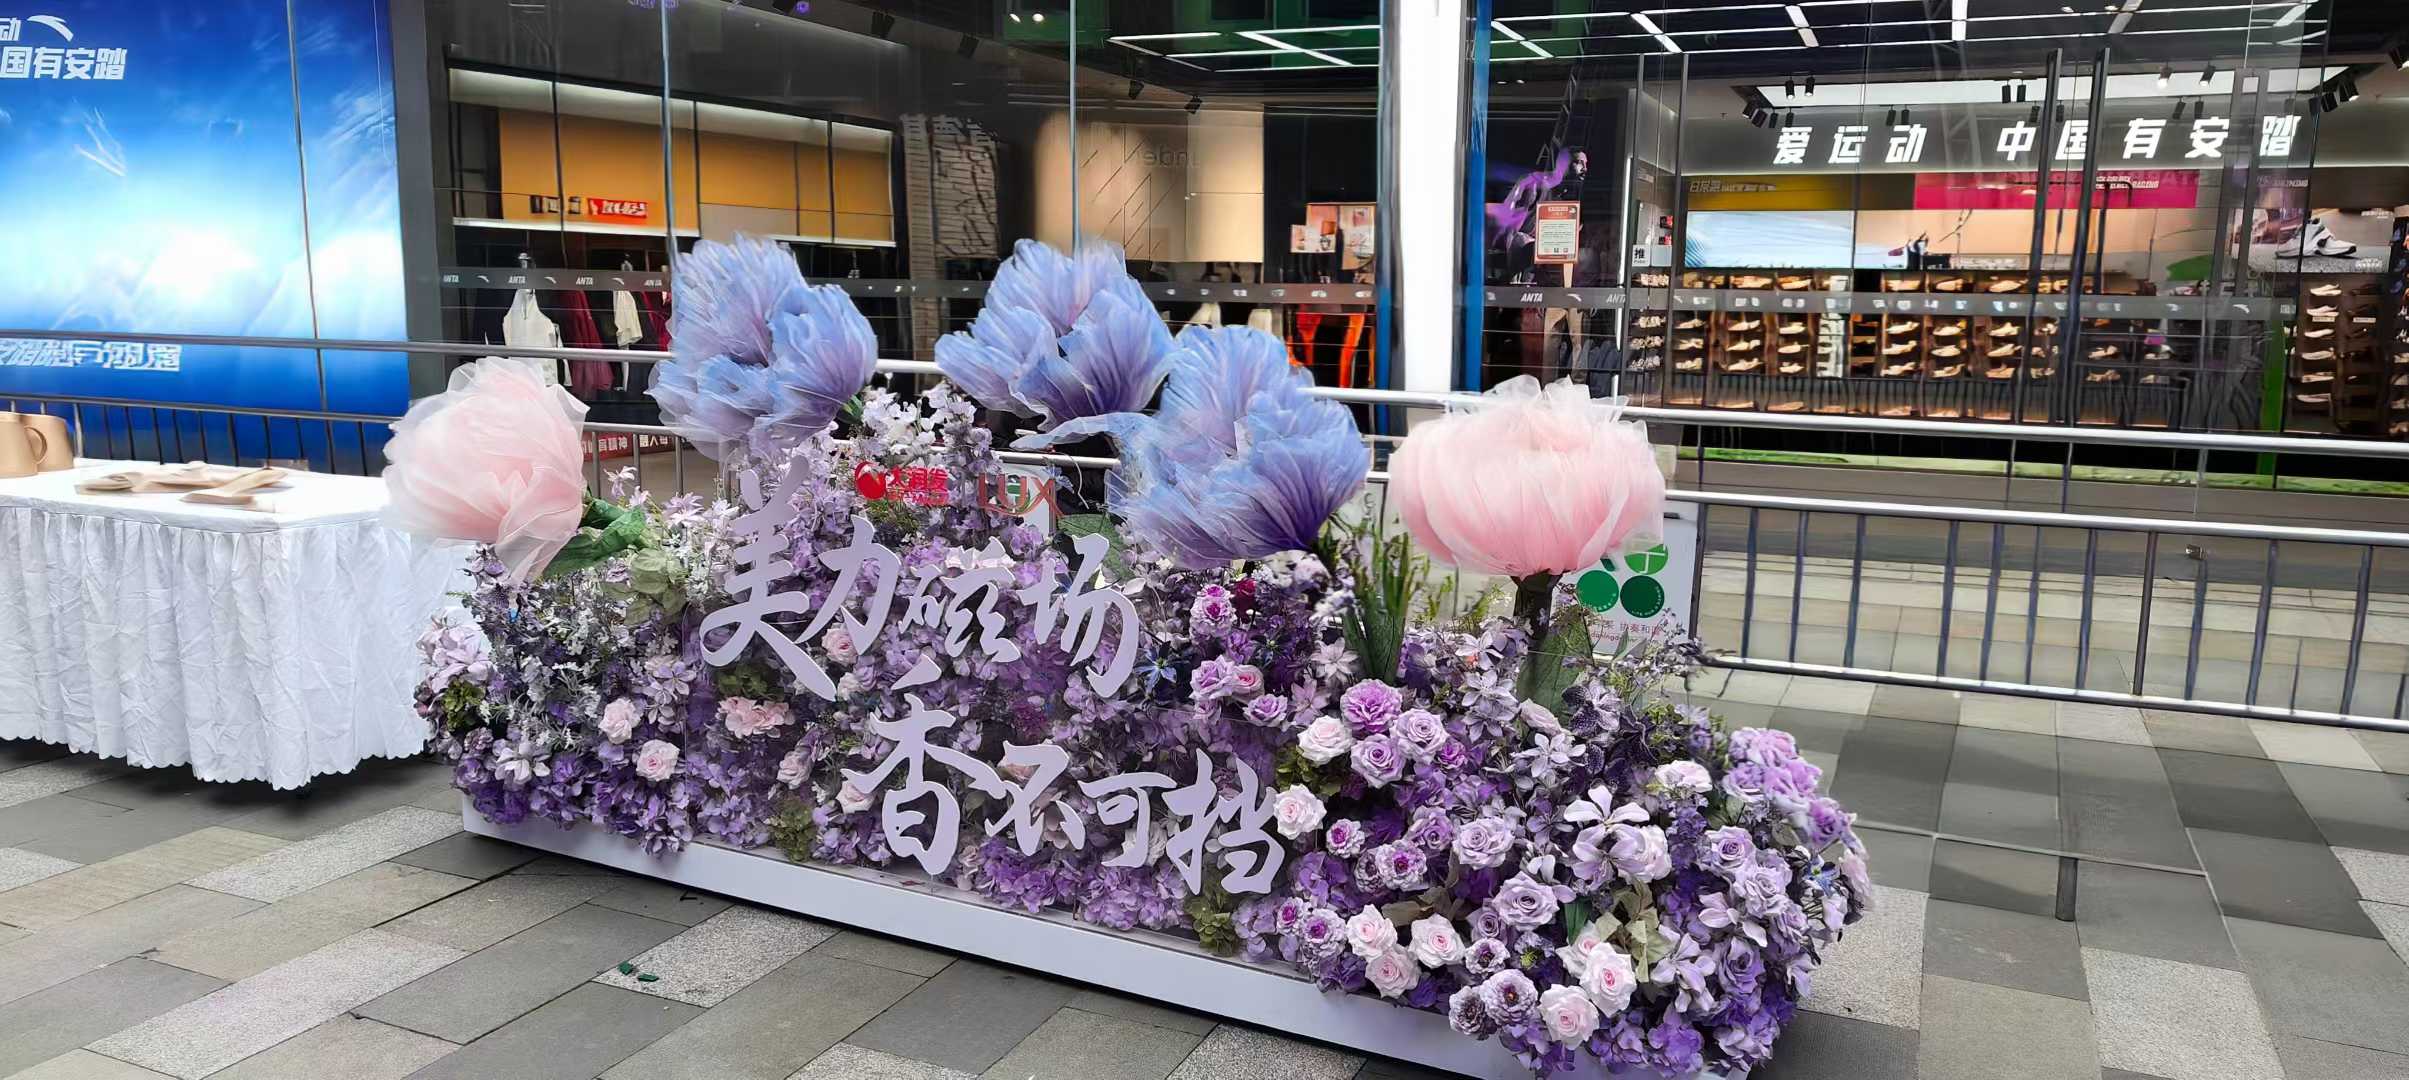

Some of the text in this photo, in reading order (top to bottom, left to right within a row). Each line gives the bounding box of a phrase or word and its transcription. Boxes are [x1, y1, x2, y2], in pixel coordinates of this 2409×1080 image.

[0, 46, 127, 80] 国有安踏
[1773, 115, 2302, 164] 爱运动 中国有安踏
[1634, 247, 1645, 259] 推
[508, 275, 526, 284] ANTA
[575, 277, 593, 285] ANTA
[1520, 293, 1543, 302] ANTA
[977, 472, 1063, 516] LUX
[700, 454, 1138, 701] 美力磁场
[841, 655, 1287, 896] 香不可挡
